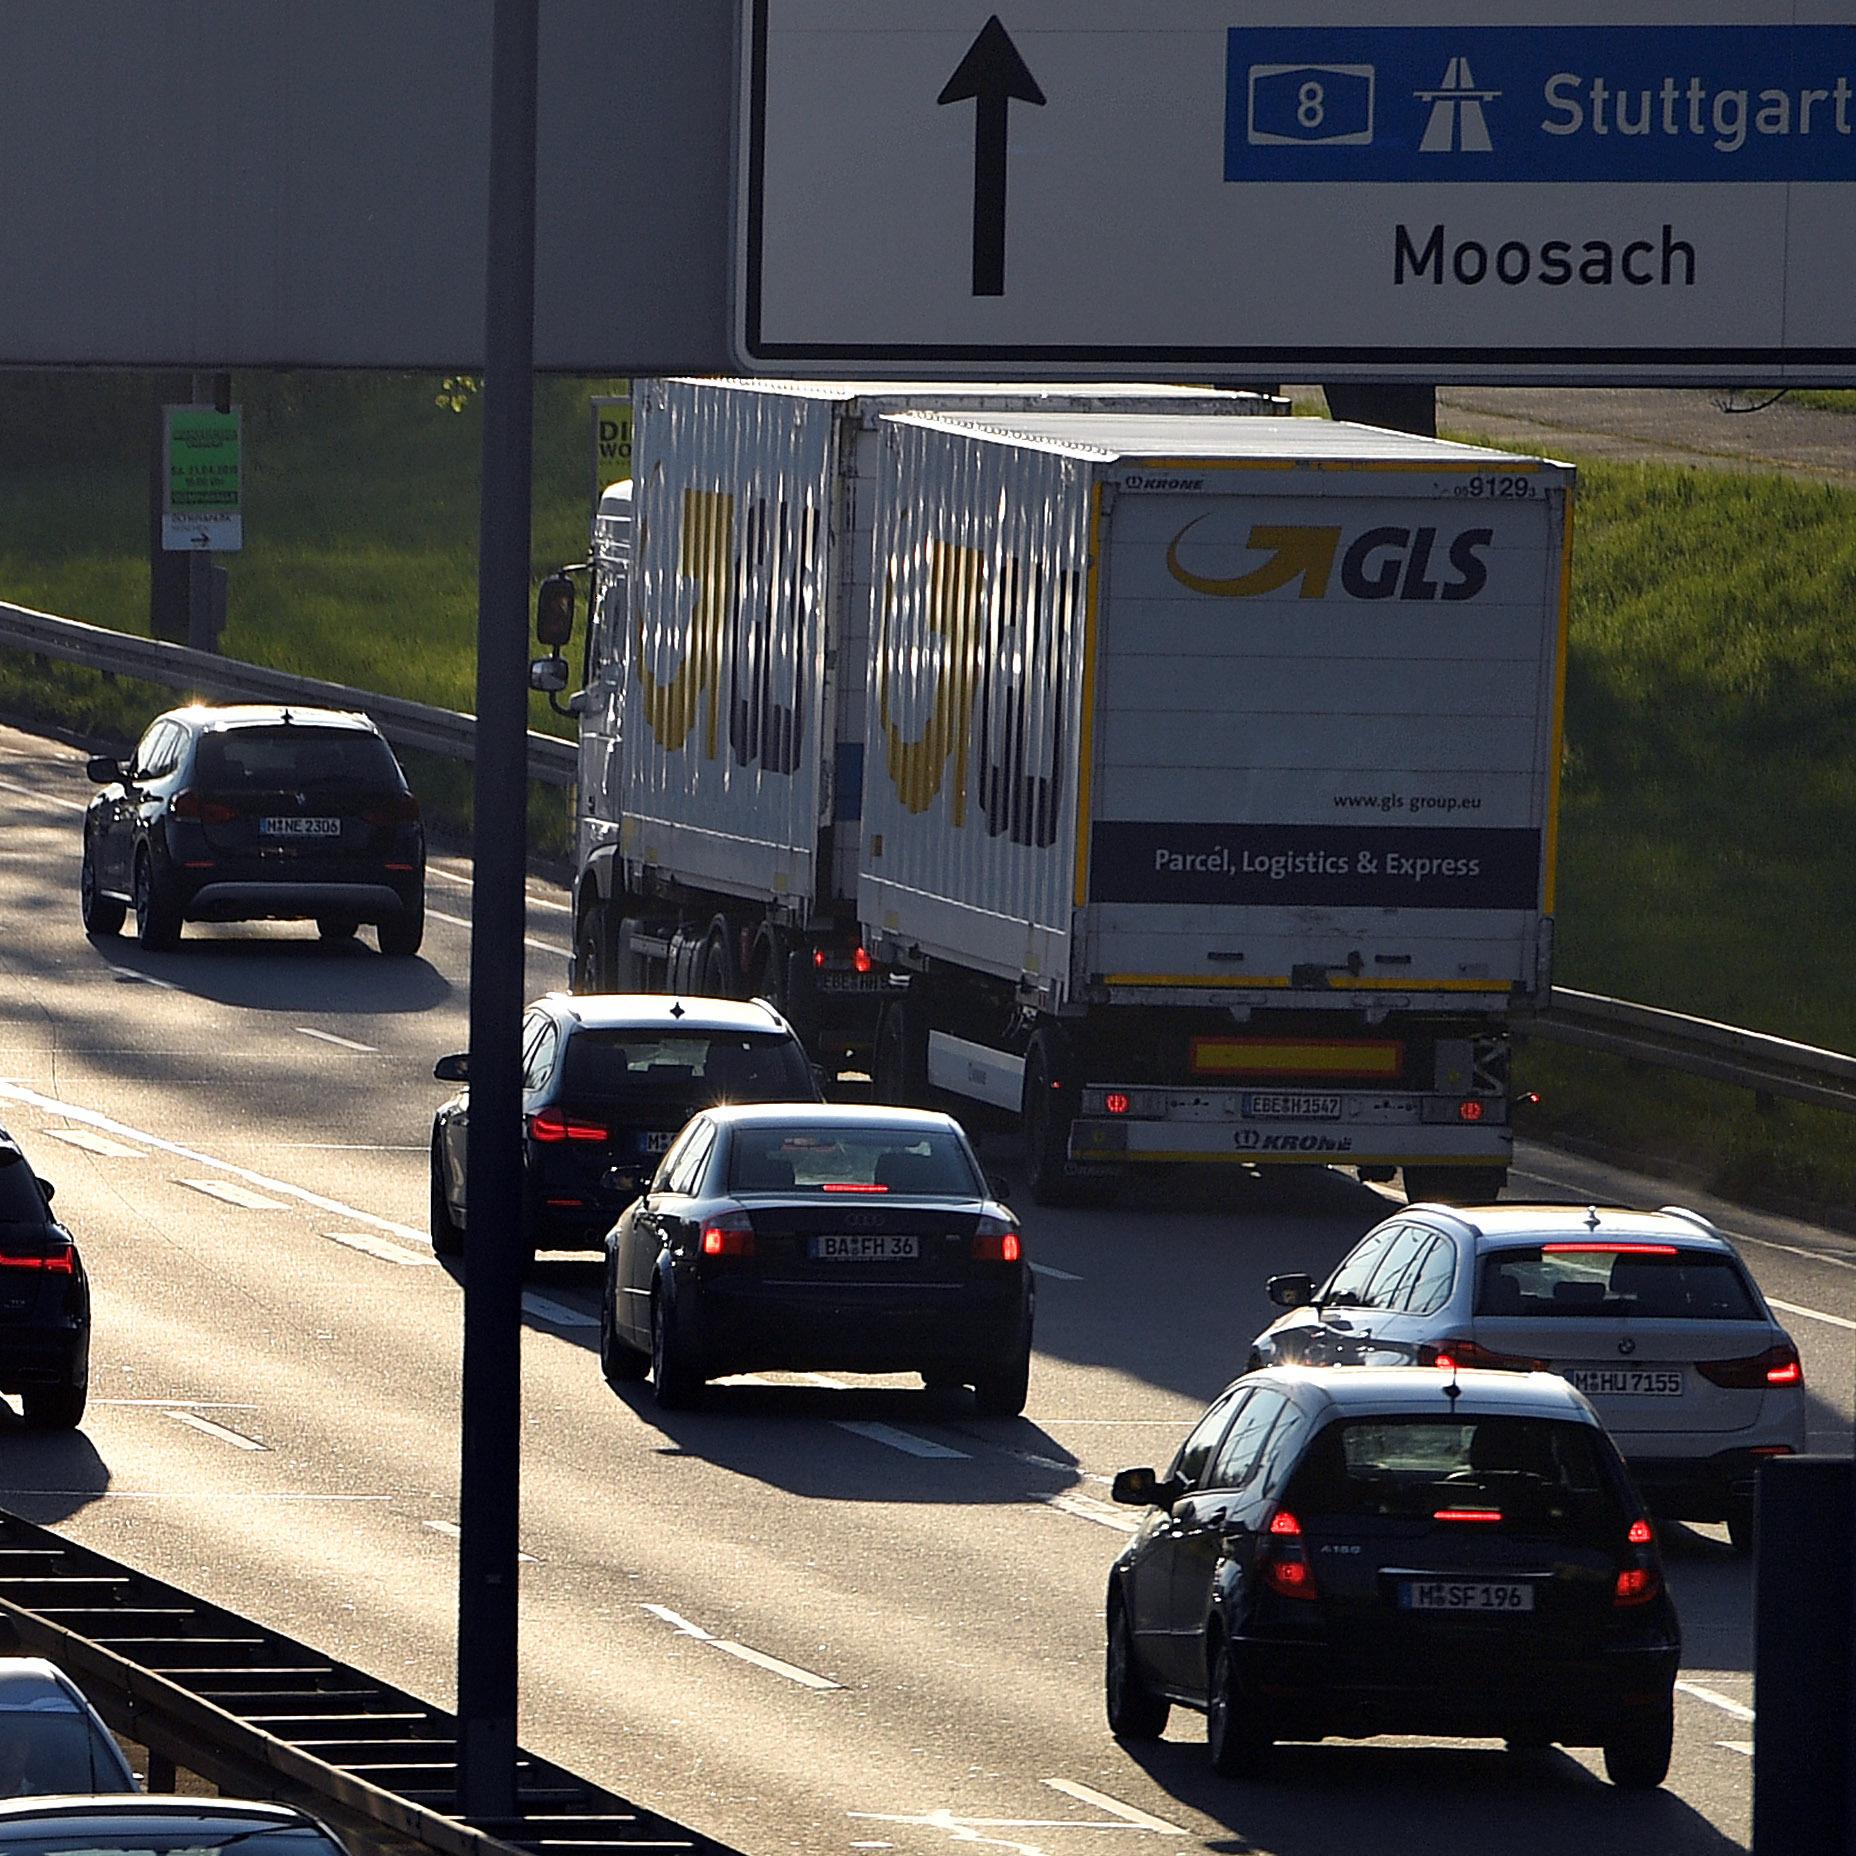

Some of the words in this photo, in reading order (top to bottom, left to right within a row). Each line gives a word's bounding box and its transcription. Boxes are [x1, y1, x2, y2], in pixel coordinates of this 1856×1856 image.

[1297, 82, 1323, 127] 8
[1542, 74, 1852, 152] Stuttgart
[1393, 225, 1695, 286] Moosach
[600, 421, 632, 441] DI
[1470, 477, 1528, 496] 9129
[1341, 526, 1494, 600] GLS
[1243, 850, 1350, 880] Logistics
[1357, 851, 1378, 874] &
[1386, 853, 1480, 881] Express
[648, 1135, 659, 1150] M
[1263, 1135, 1352, 1151] KRONE
[824, 1238, 849, 1255] BA
[861, 1238, 885, 1255] FH
[890, 1238, 914, 1255] 36
[1576, 1373, 1588, 1391] M
[1601, 1373, 1626, 1391] HU
[1631, 1374, 1680, 1393] 7155
[1419, 1586, 1433, 1605] M
[1449, 1586, 1475, 1606] SF
[1481, 1587, 1521, 1607] 196
